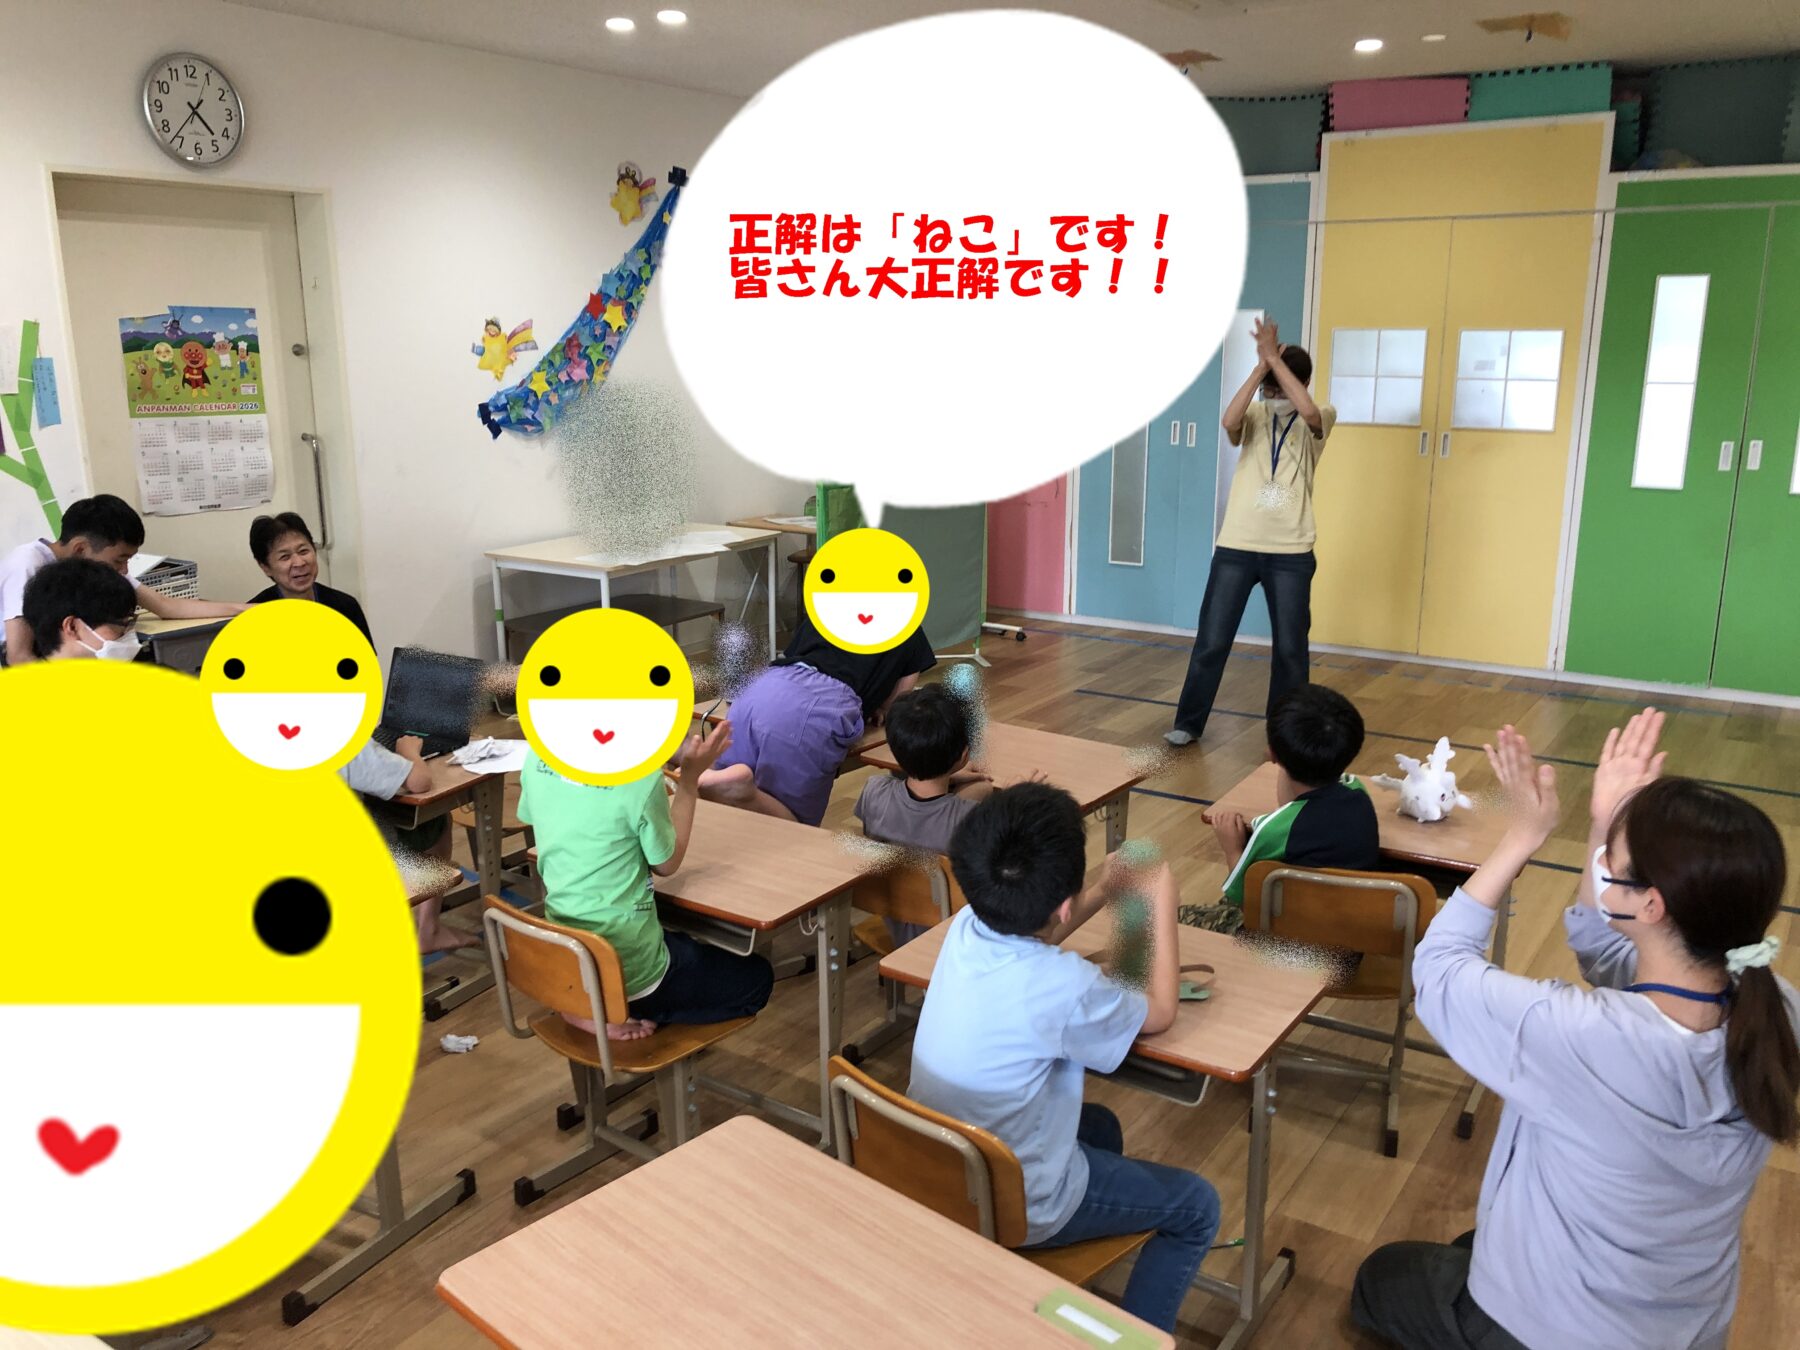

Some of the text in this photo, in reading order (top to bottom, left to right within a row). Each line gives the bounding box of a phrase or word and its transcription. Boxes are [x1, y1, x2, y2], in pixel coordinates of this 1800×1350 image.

[168, 67, 179, 82] 11
[184, 64, 198, 80] 12
[205, 72, 210, 86] 1
[156, 80, 170, 95] 10
[218, 88, 226, 102] 2
[154, 99, 163, 113] 9
[224, 108, 233, 122] 3
[161, 119, 171, 134] 8
[221, 127, 230, 141] 4
[176, 135, 185, 149] 7
[194, 142, 203, 156] 6
[211, 139, 219, 153] 5
[136, 402, 259, 413] ANPANMAN CALENDAR 2026
